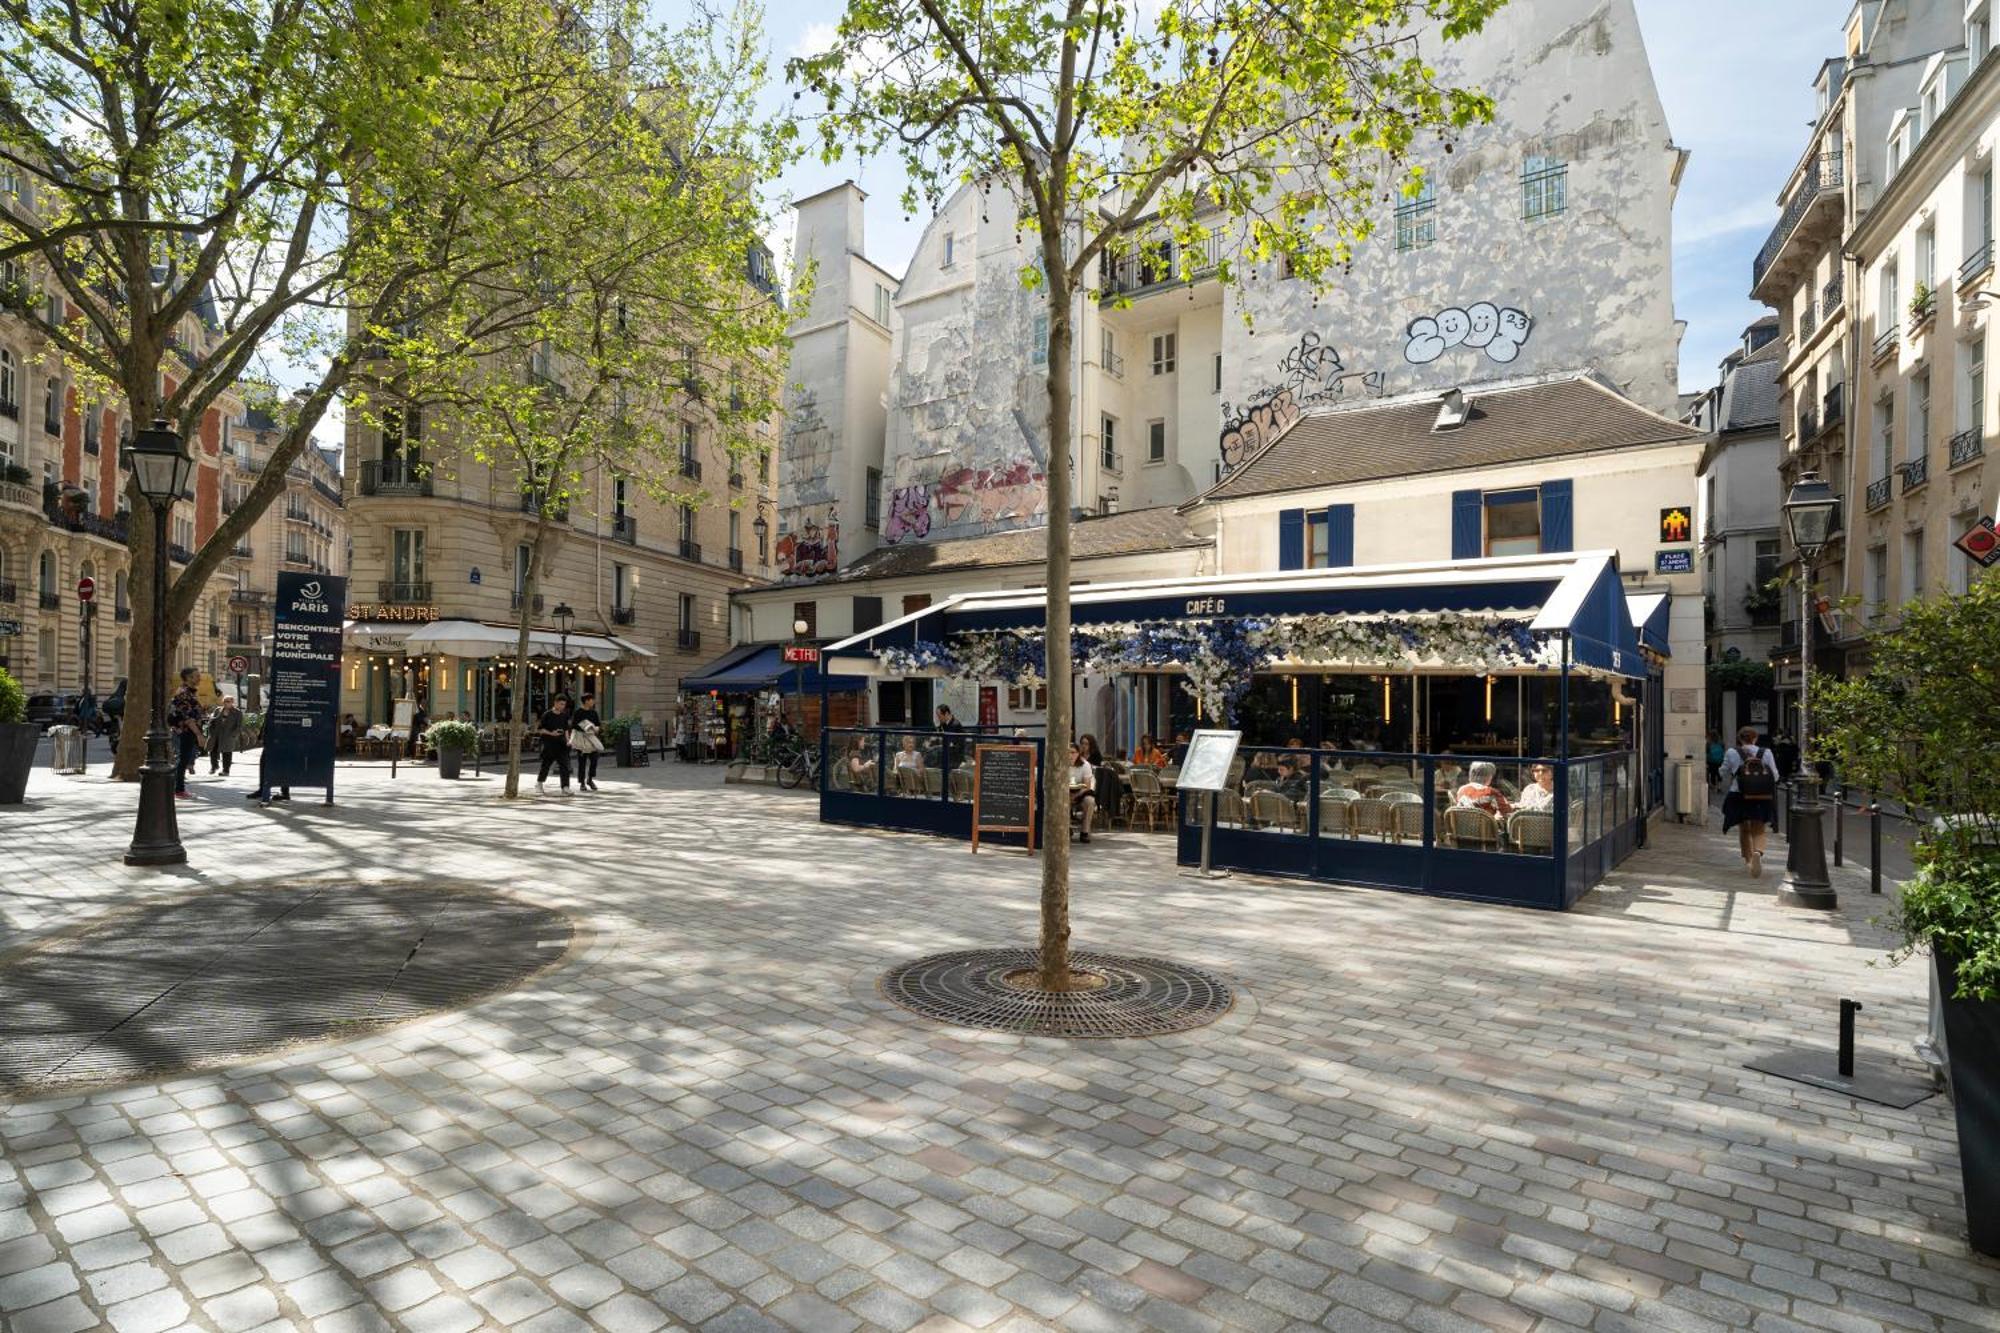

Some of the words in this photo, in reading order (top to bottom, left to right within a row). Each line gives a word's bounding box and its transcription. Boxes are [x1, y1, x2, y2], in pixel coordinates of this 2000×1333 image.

[292, 602, 329, 613] PARIS
[1187, 597, 1213, 613] CAFÉ
[1217, 599, 1225, 613] G
[350, 604, 370, 619] ST
[376, 605, 439, 620] ANDRE
[277, 624, 340, 634] RENCONTREZ
